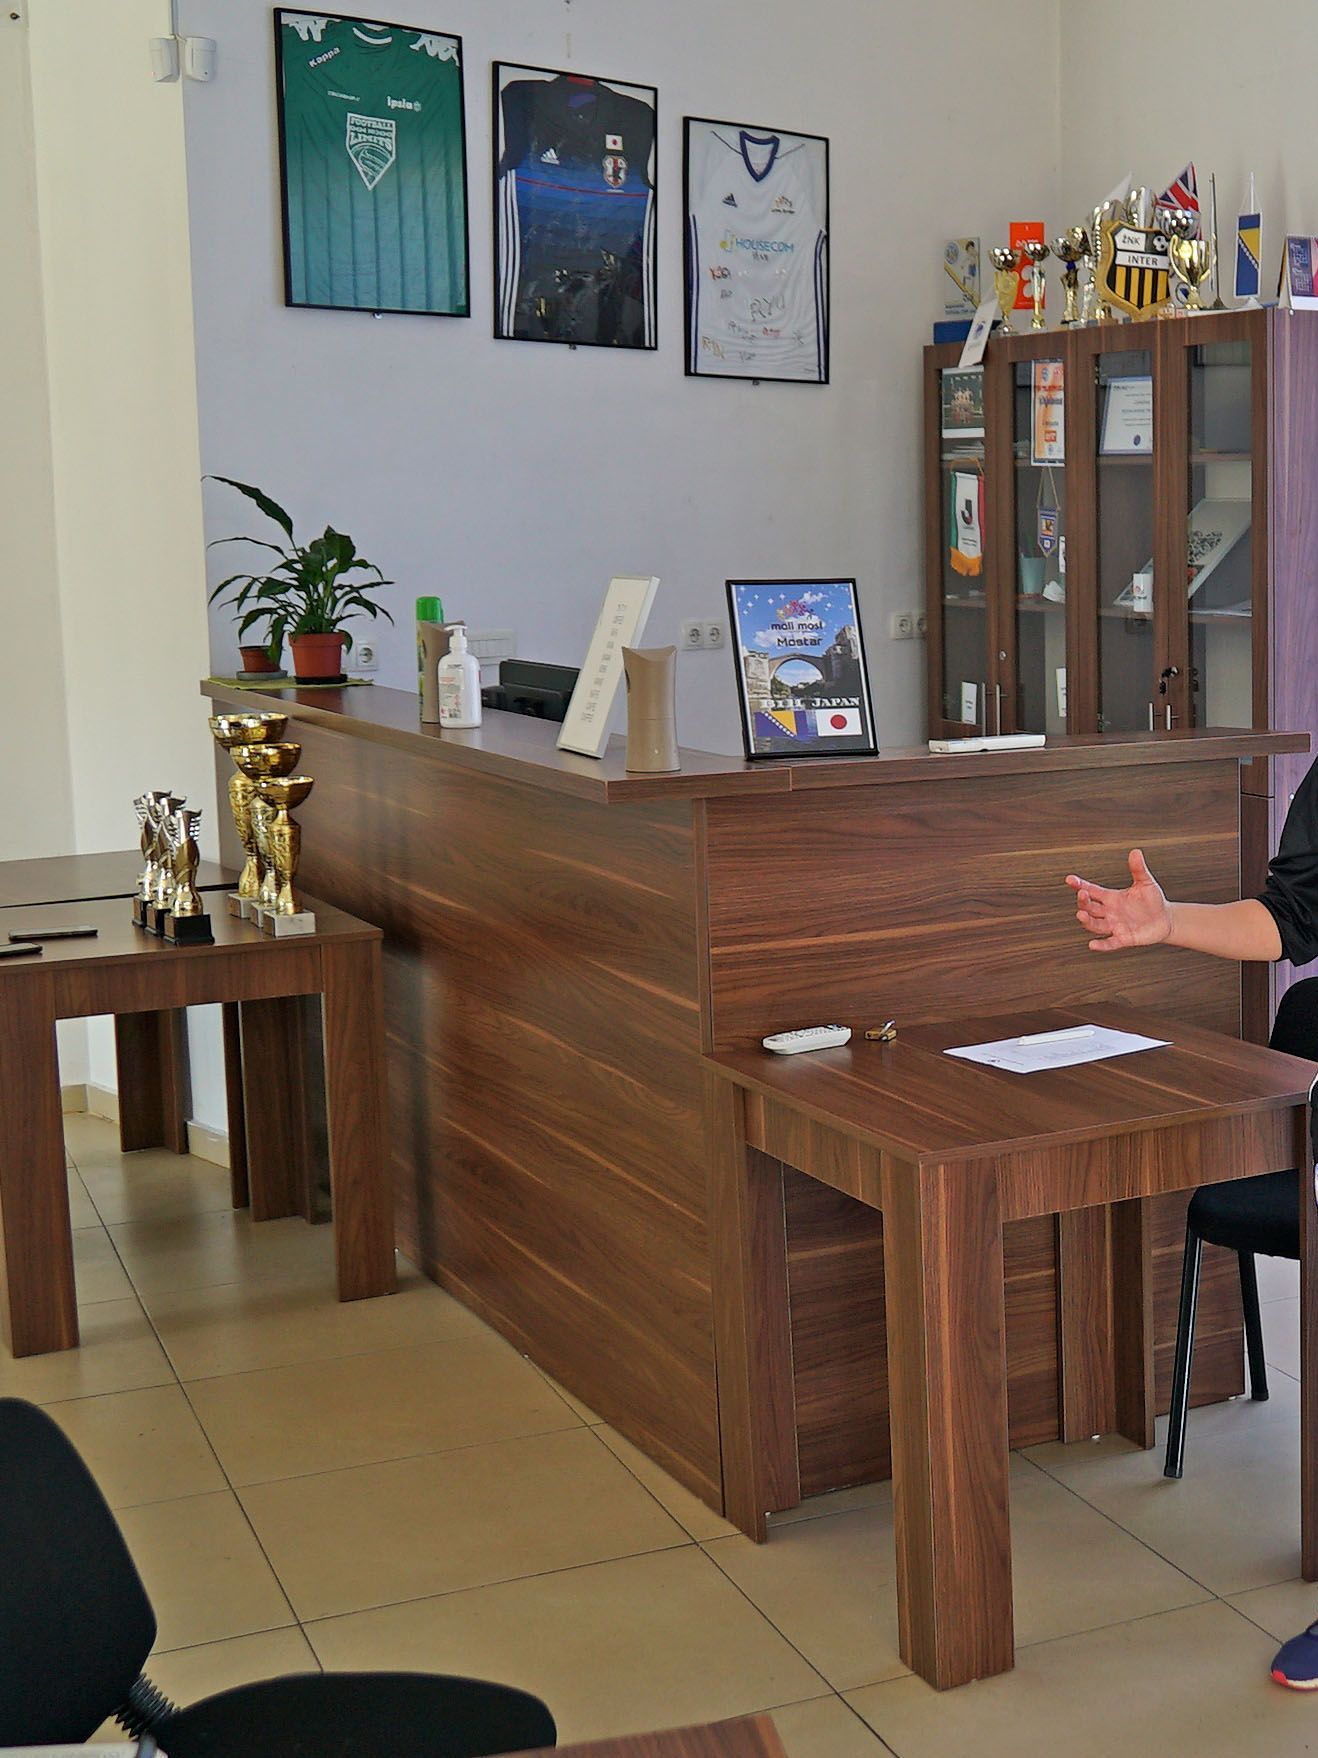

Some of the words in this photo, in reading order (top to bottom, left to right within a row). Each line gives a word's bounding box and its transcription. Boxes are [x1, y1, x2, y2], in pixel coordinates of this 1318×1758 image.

[309, 47, 341, 68] Kappa
[351, 115, 392, 129] FOOTBALL
[350, 132, 392, 151] LIMITS
[736, 238, 794, 252] HOUSECOM
[1128, 254, 1159, 266] INTER
[777, 637, 823, 647] Mostar
[812, 697, 860, 707] JAPAN
